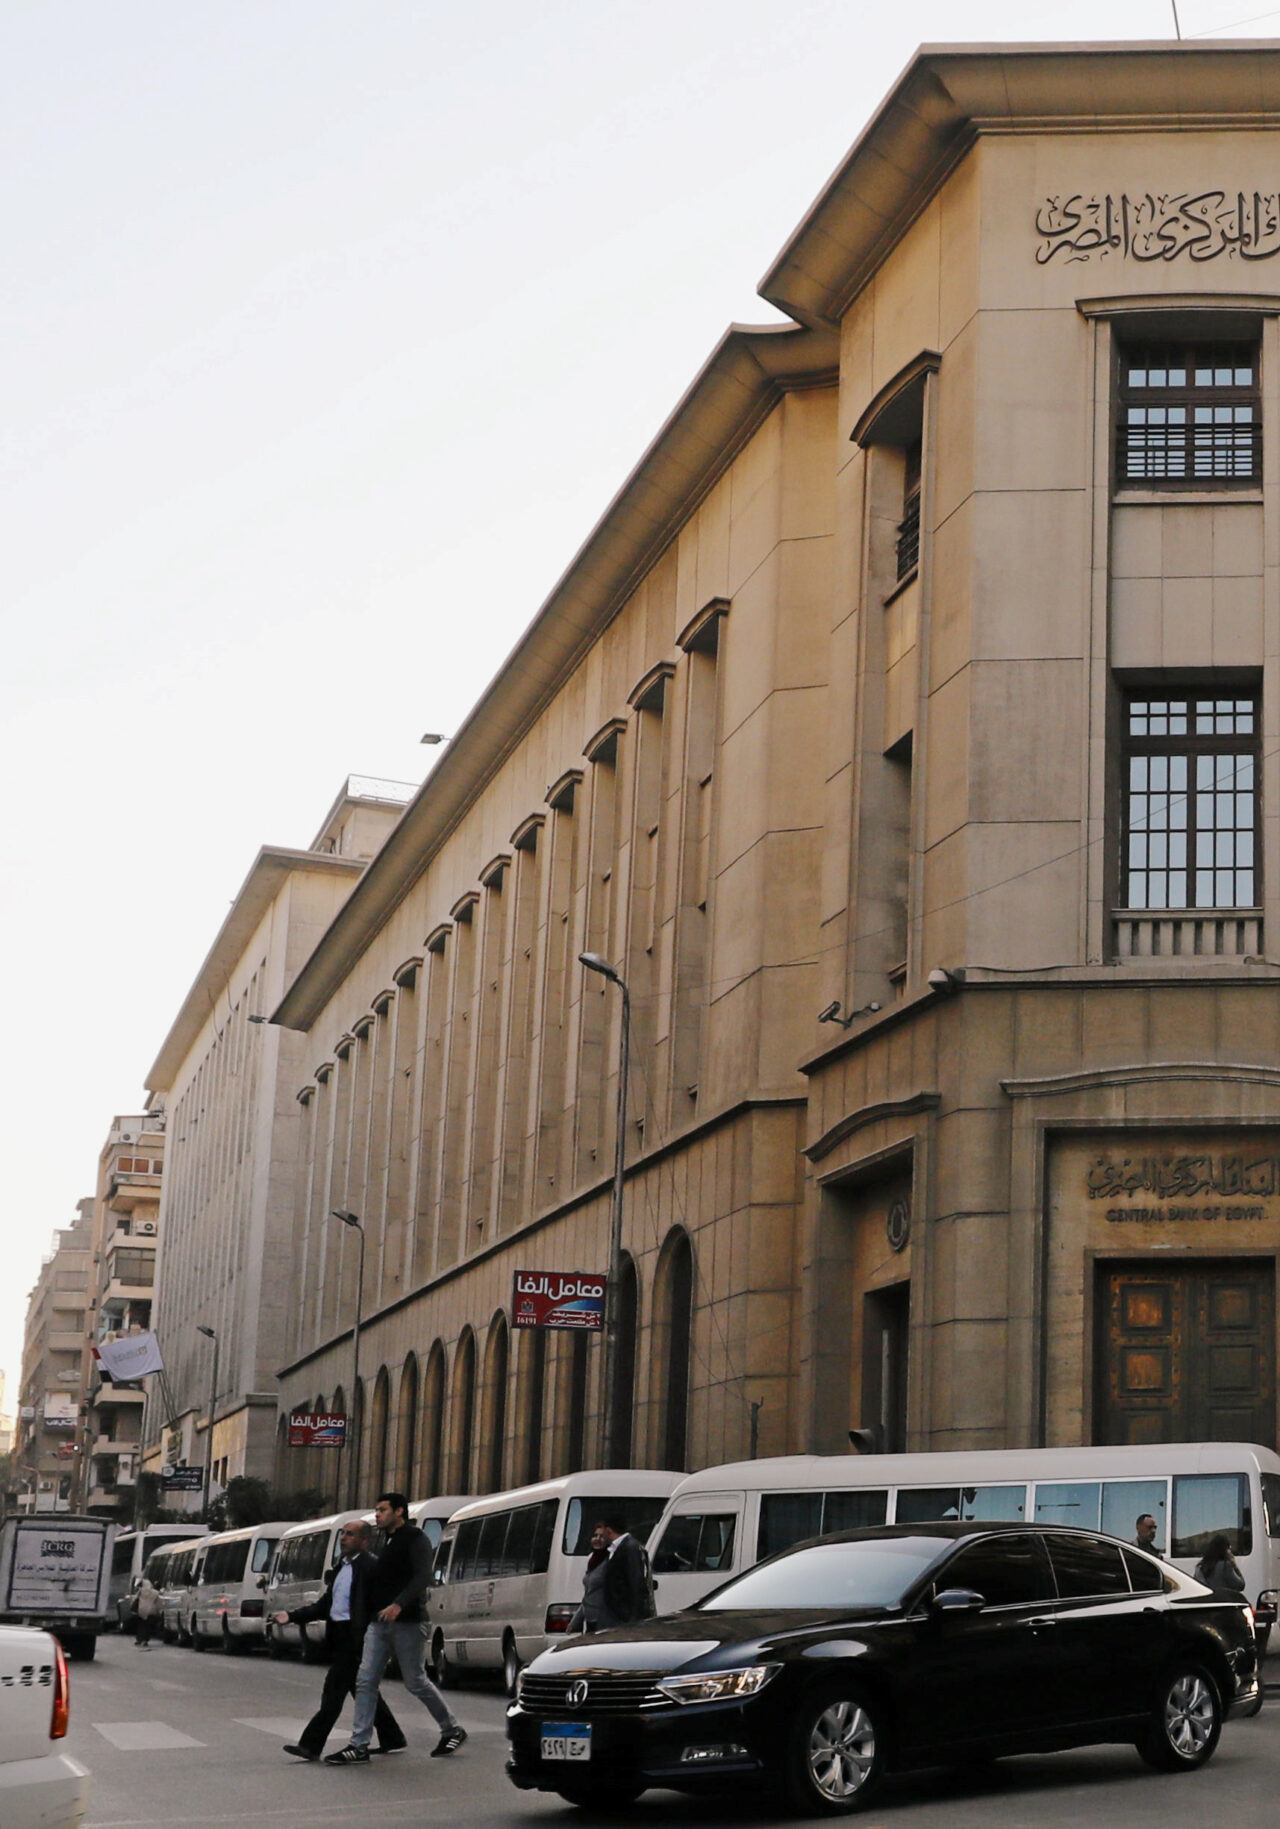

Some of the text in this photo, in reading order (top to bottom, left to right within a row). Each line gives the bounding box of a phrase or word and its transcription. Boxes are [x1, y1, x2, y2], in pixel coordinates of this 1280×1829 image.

[1104, 1205, 1265, 1223] CENTRAL BANK OF EGYPT
[548, 1278, 604, 1301] معامل
